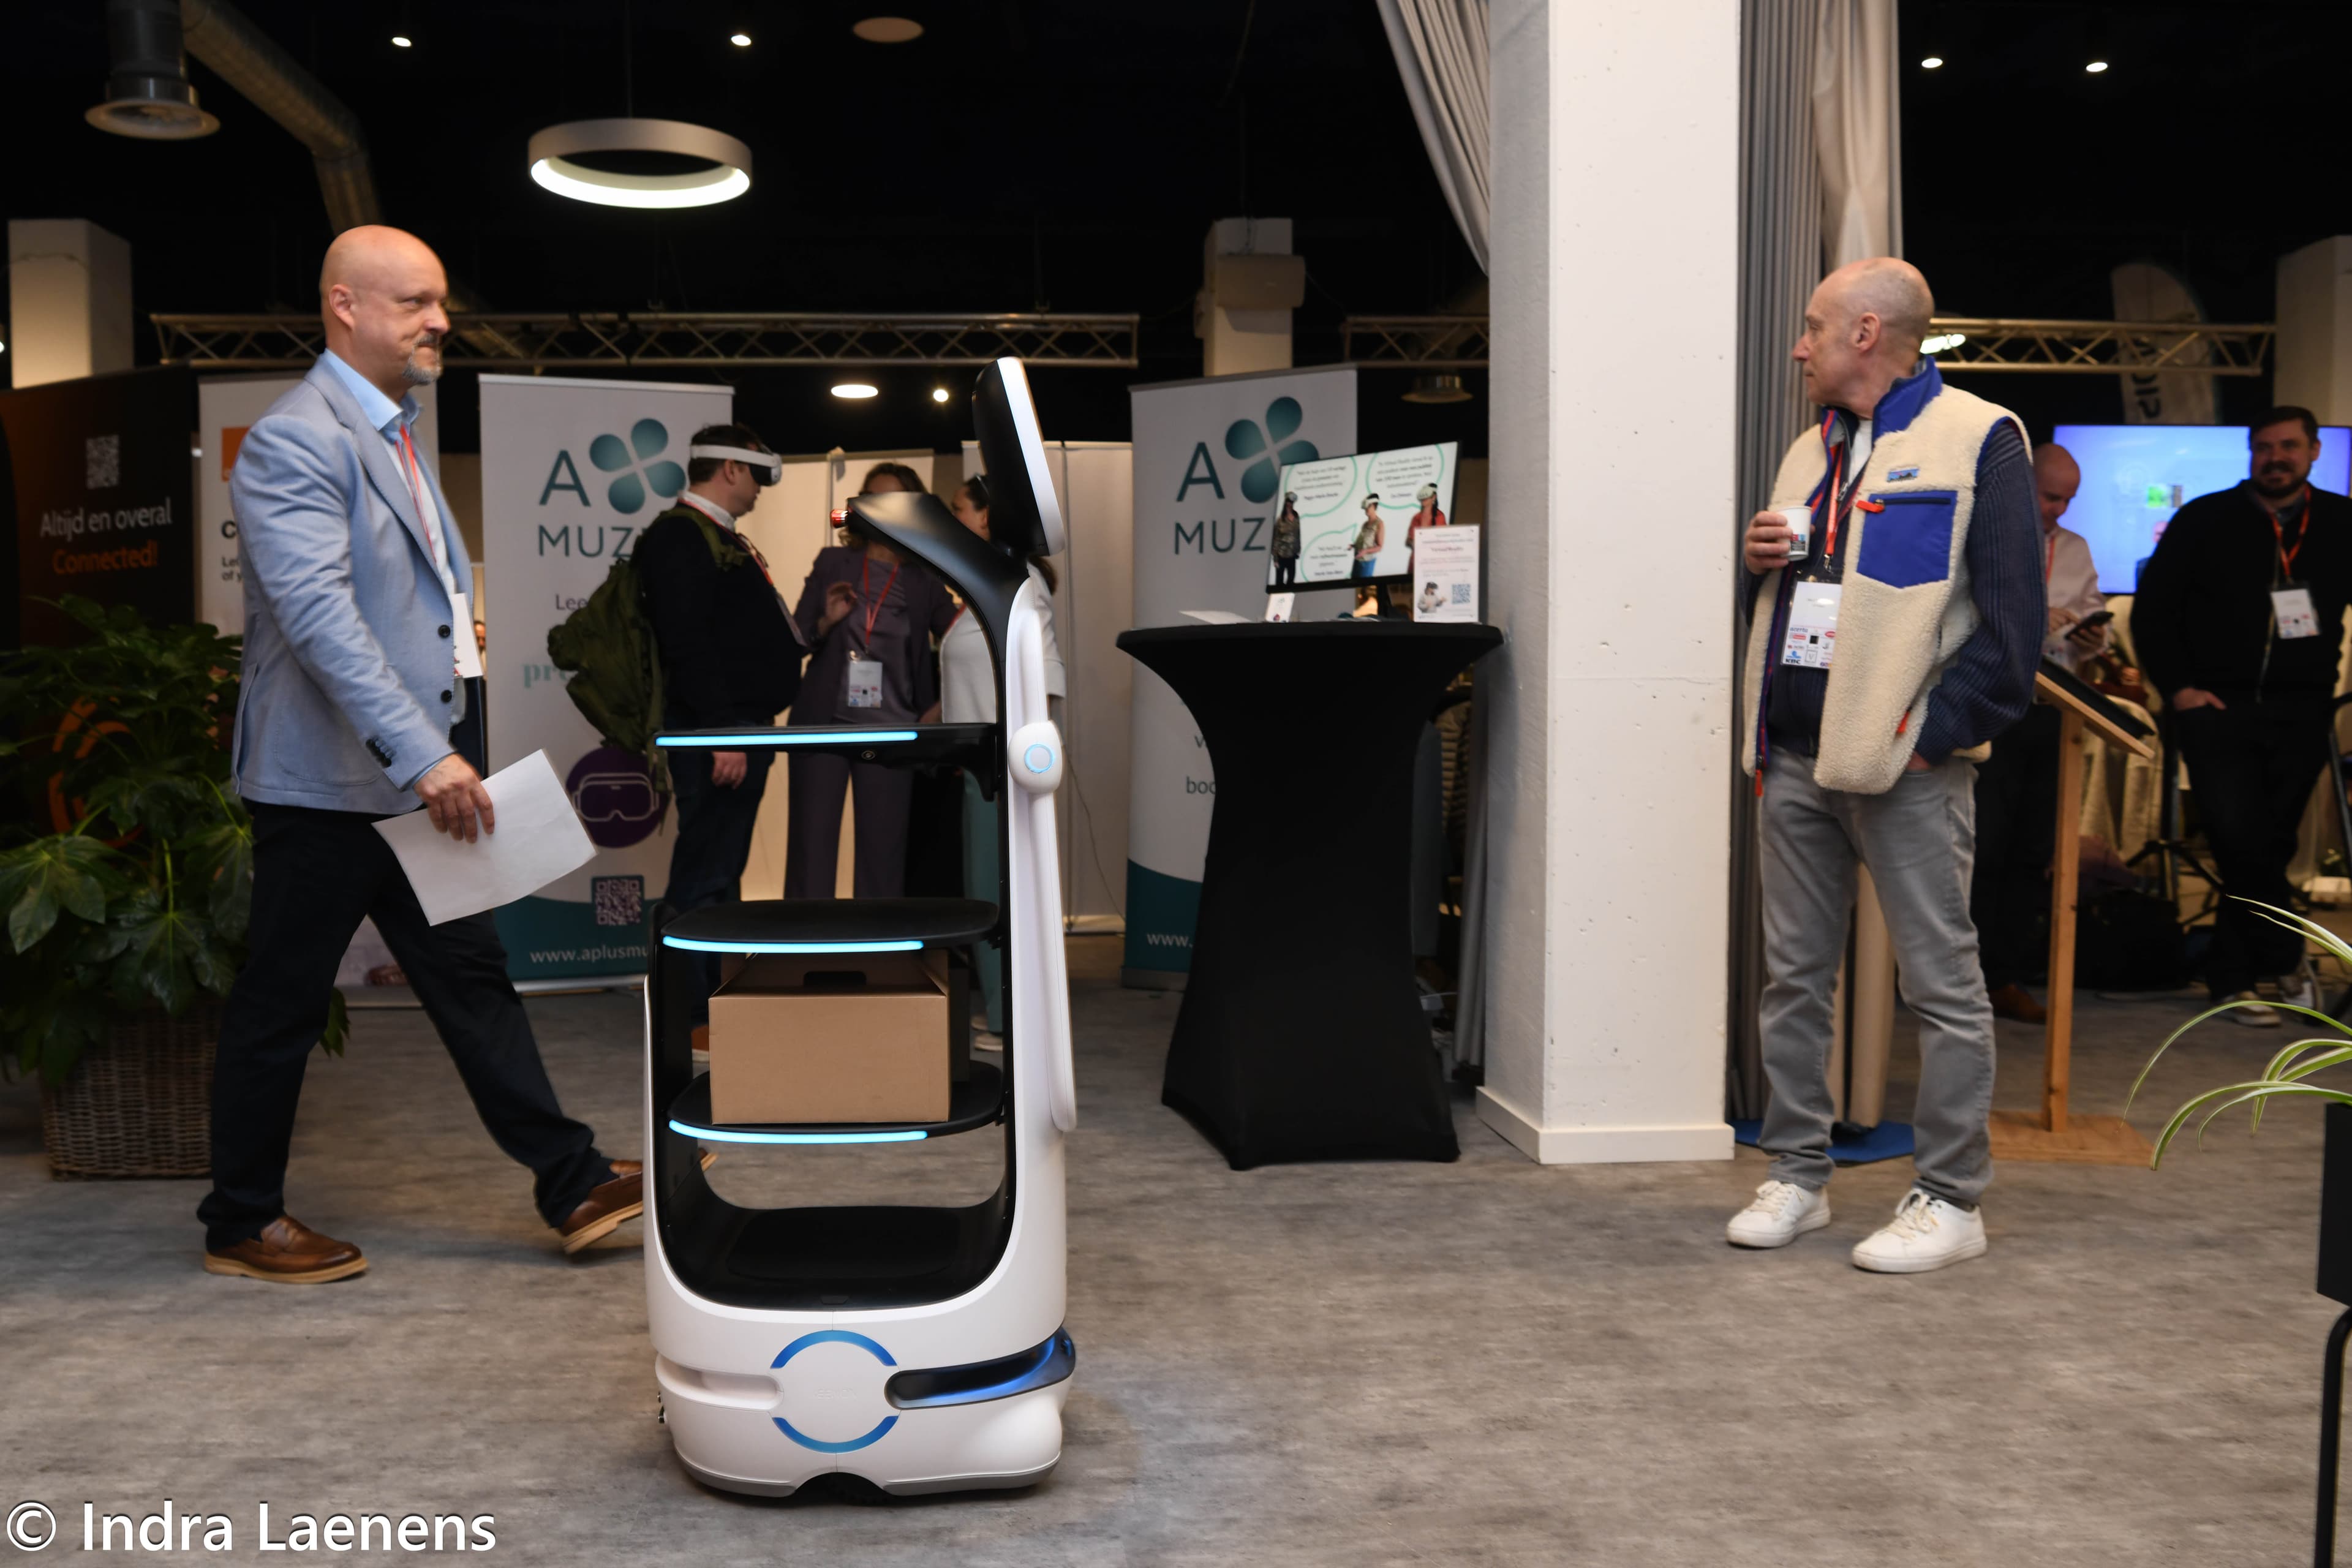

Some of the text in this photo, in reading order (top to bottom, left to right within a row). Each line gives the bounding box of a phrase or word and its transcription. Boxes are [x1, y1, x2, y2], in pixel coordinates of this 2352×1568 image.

[538, 449, 591, 507] A
[1176, 442, 1226, 502] A
[40, 497, 172, 543] Altijd en overal
[538, 524, 648, 558] MUZ
[53, 539, 158, 575] Connected!
